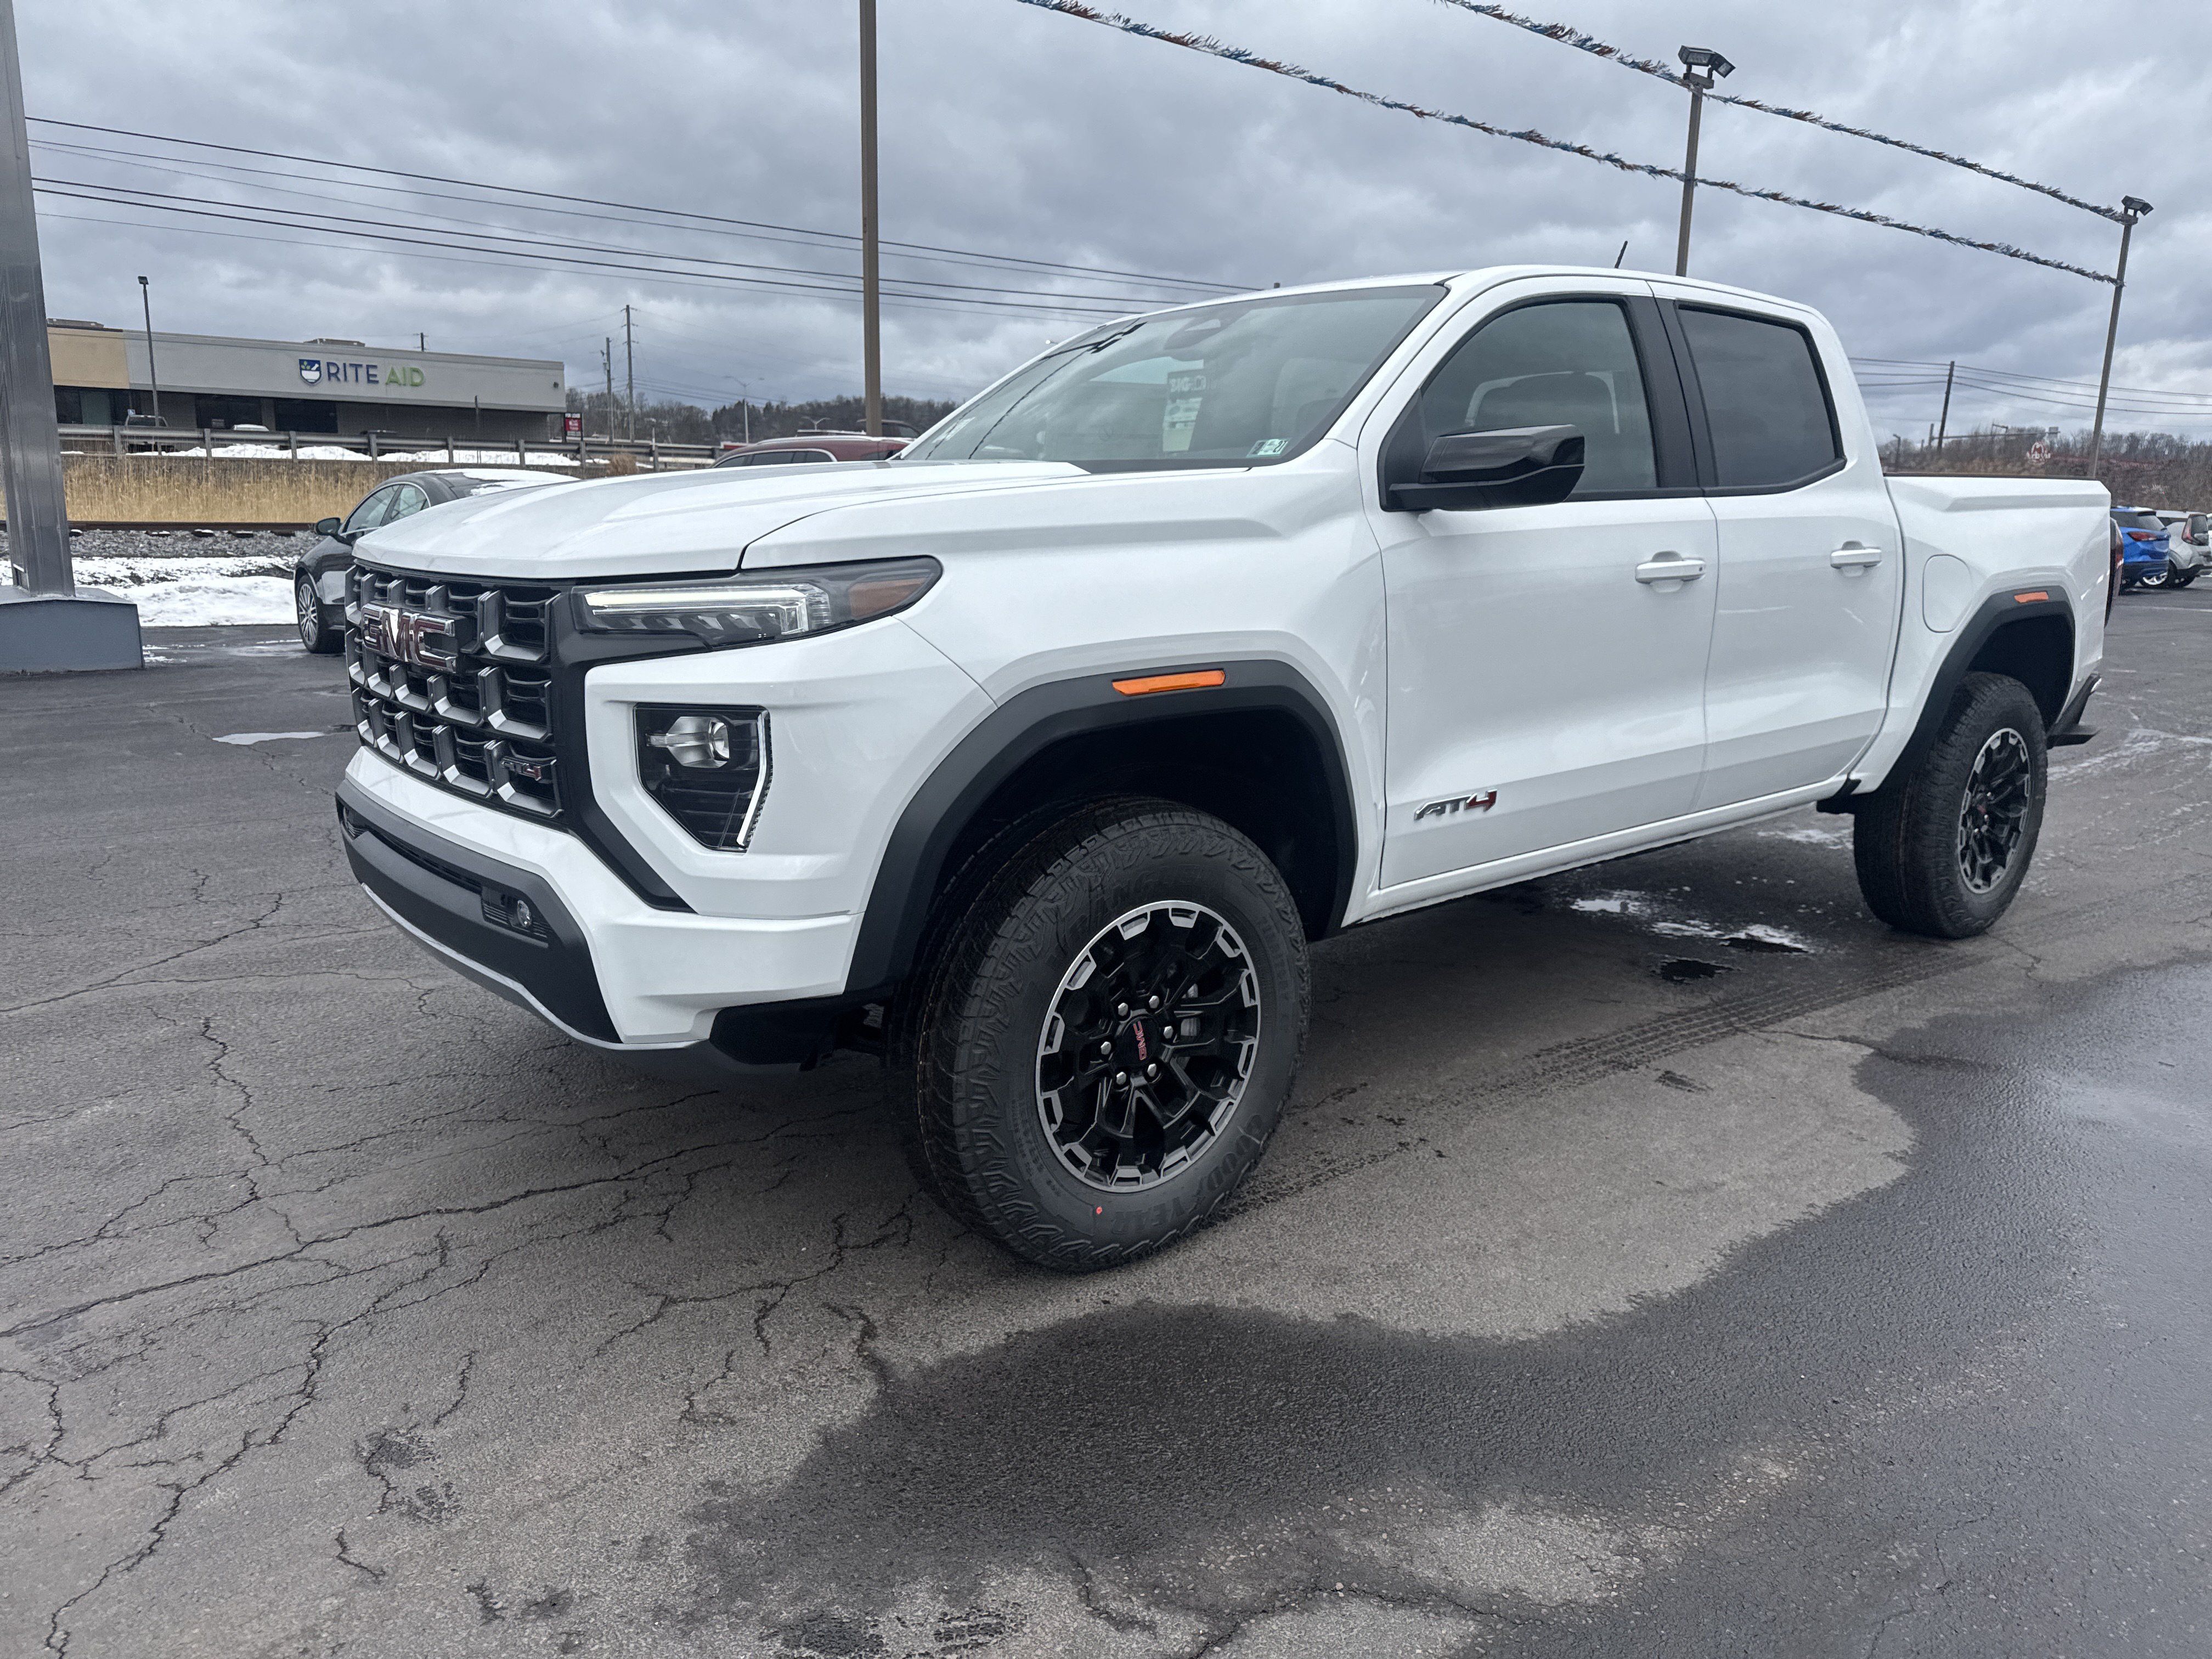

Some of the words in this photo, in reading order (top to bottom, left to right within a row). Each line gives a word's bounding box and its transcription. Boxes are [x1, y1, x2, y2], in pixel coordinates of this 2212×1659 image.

[326, 361, 379, 384] RITE
[385, 366, 425, 387] AID
[361, 602, 457, 674] GMC
[1414, 789, 1498, 821] AT4
[1133, 1021, 1147, 1060] GMC
